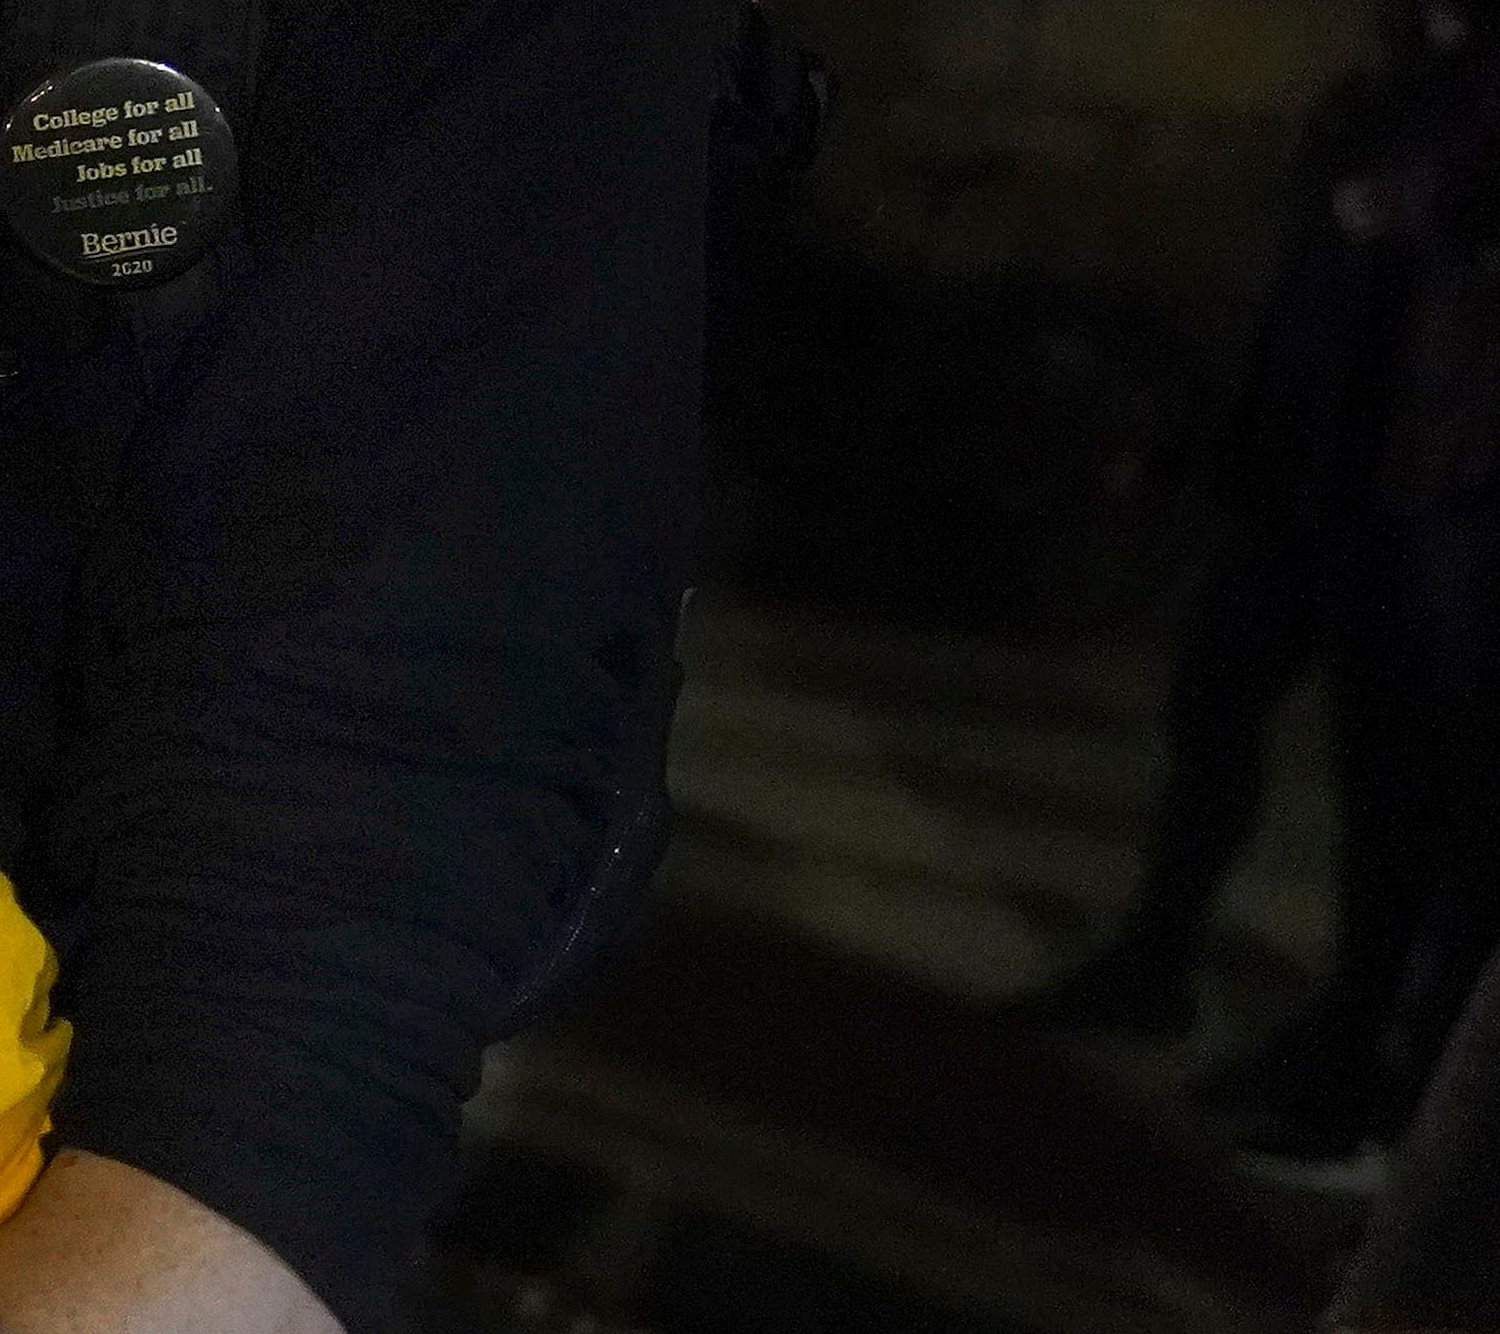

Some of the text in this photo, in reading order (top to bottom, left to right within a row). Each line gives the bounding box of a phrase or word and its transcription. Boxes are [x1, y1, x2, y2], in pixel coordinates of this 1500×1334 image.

[32, 91, 195, 132] College for all
[11, 120, 199, 164] Medicare for all
[76, 148, 203, 183] Jobs for all
[51, 188, 130, 214] Justice
[135, 183, 170, 201] for
[81, 223, 179, 256] Bernie
[112, 260, 154, 278] 2020
